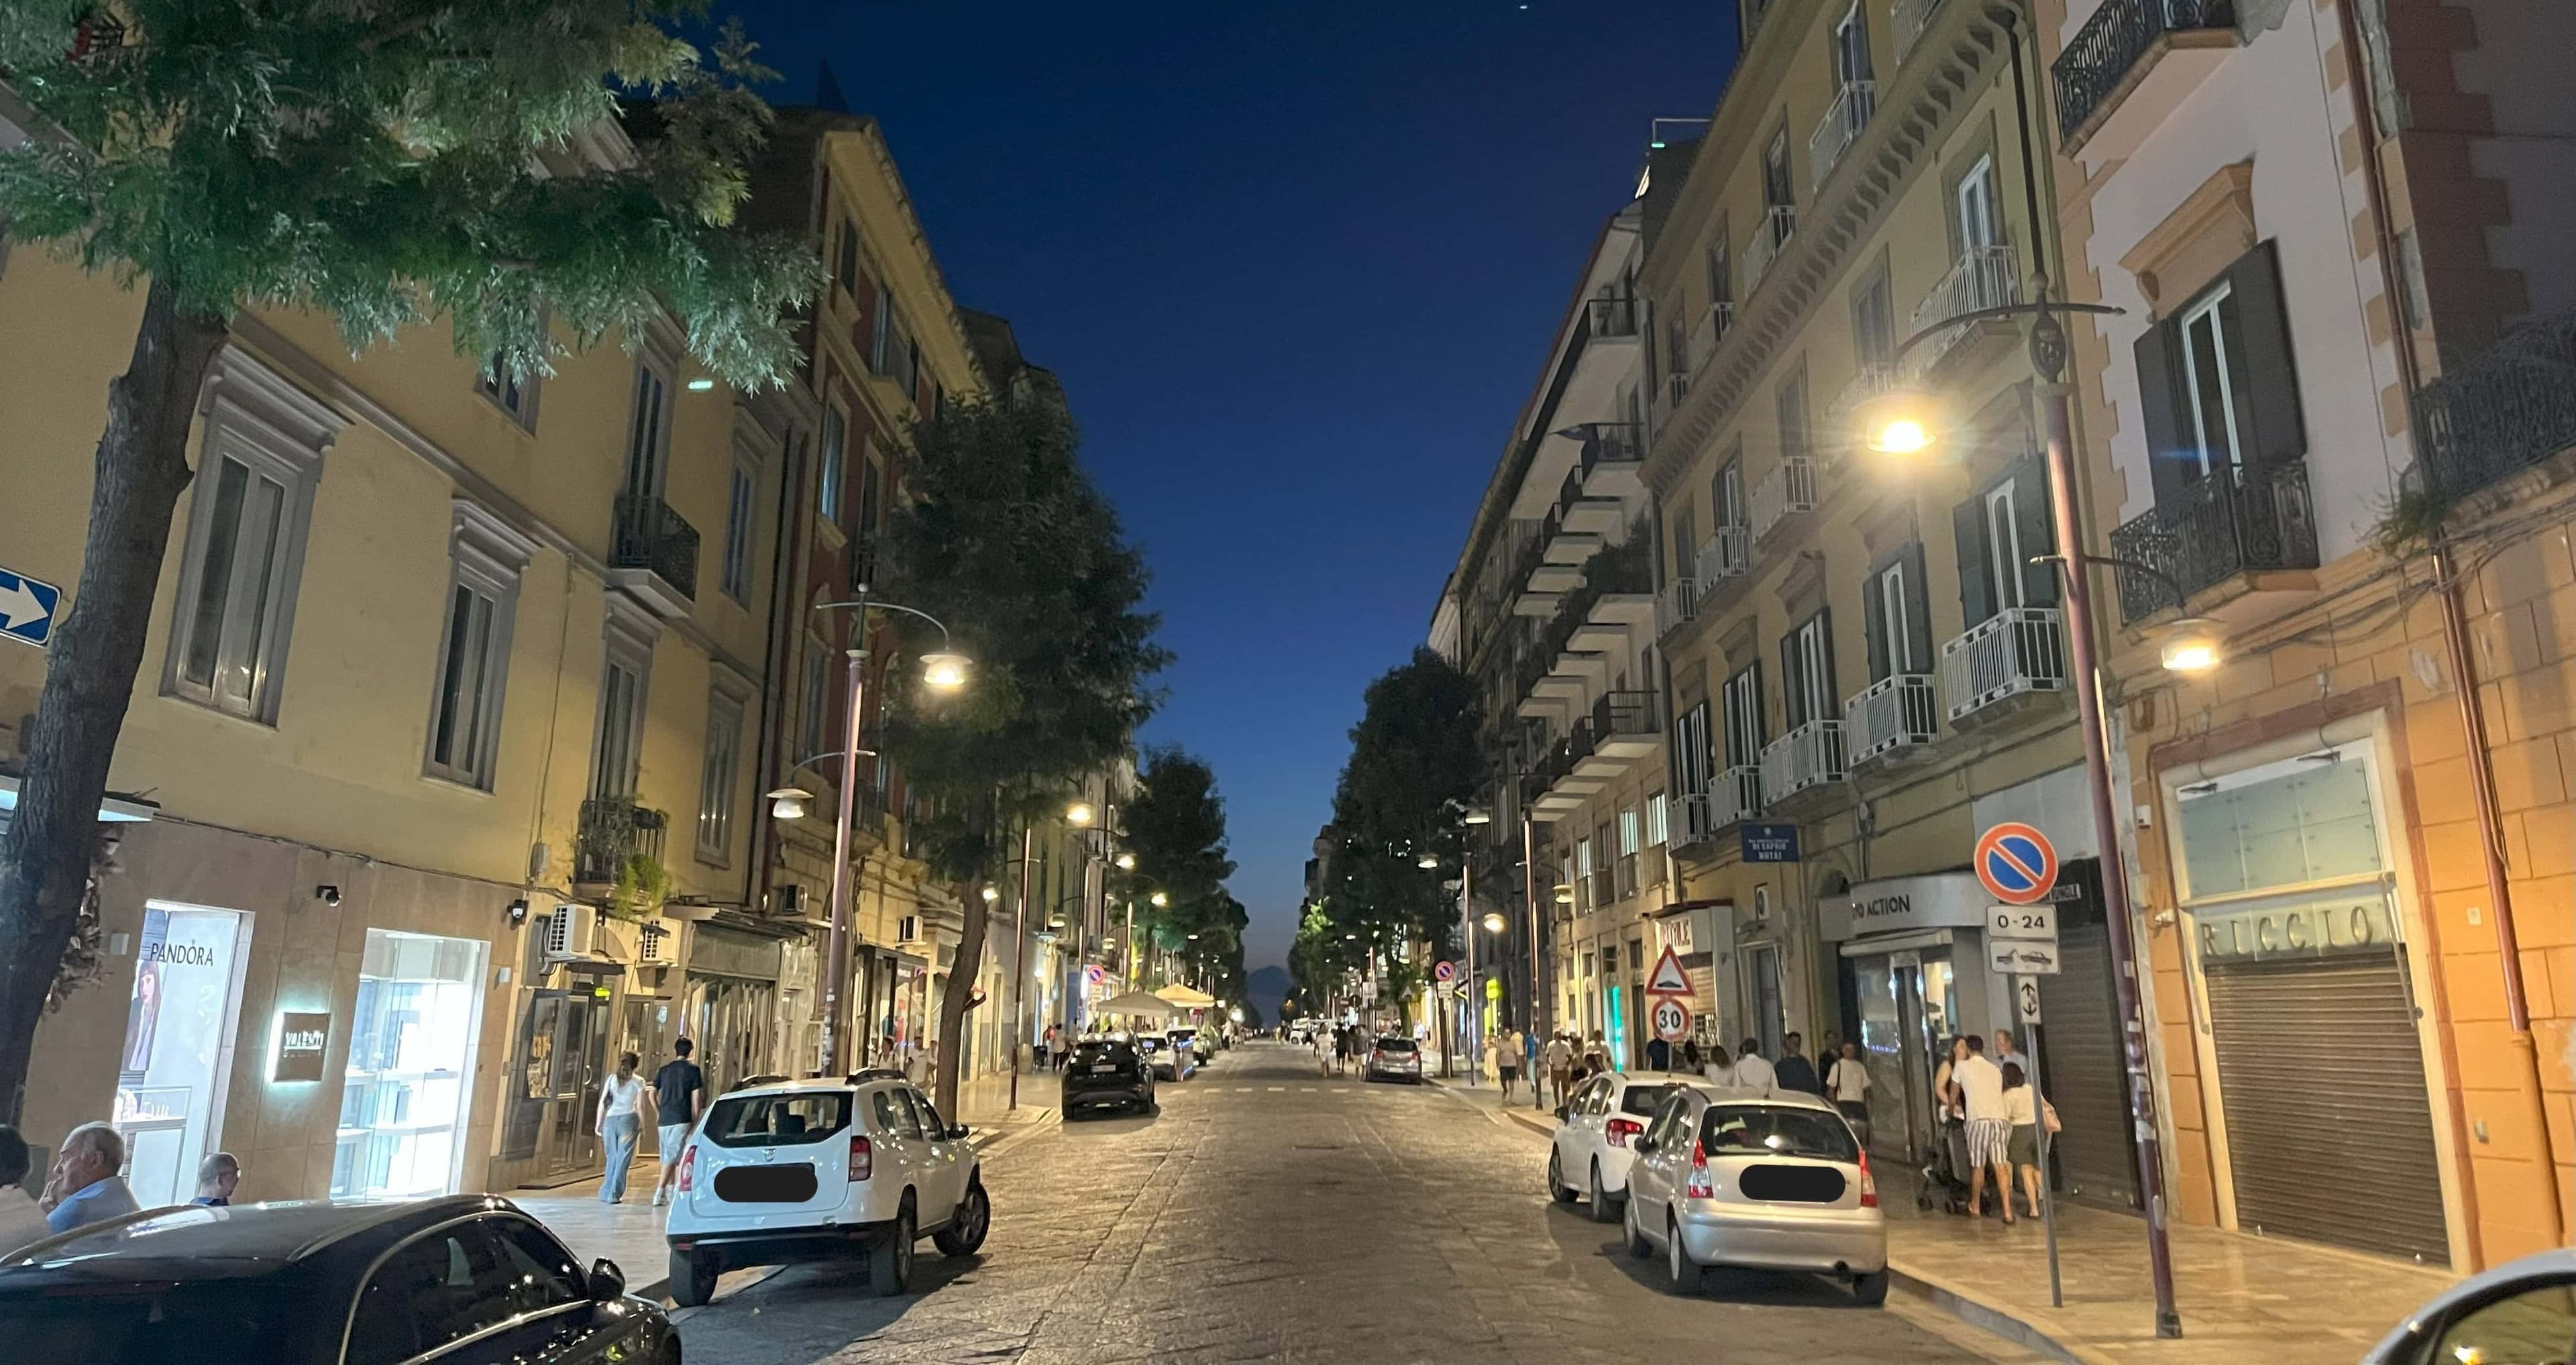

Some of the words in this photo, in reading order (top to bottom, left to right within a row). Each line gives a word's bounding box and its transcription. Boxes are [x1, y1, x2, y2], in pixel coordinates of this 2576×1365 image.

[1867, 894, 1911, 916] ACTION
[2022, 916, 2045, 928] 24
[150, 942, 213, 967] PANDORA
[1659, 1009, 1681, 1029] 30
